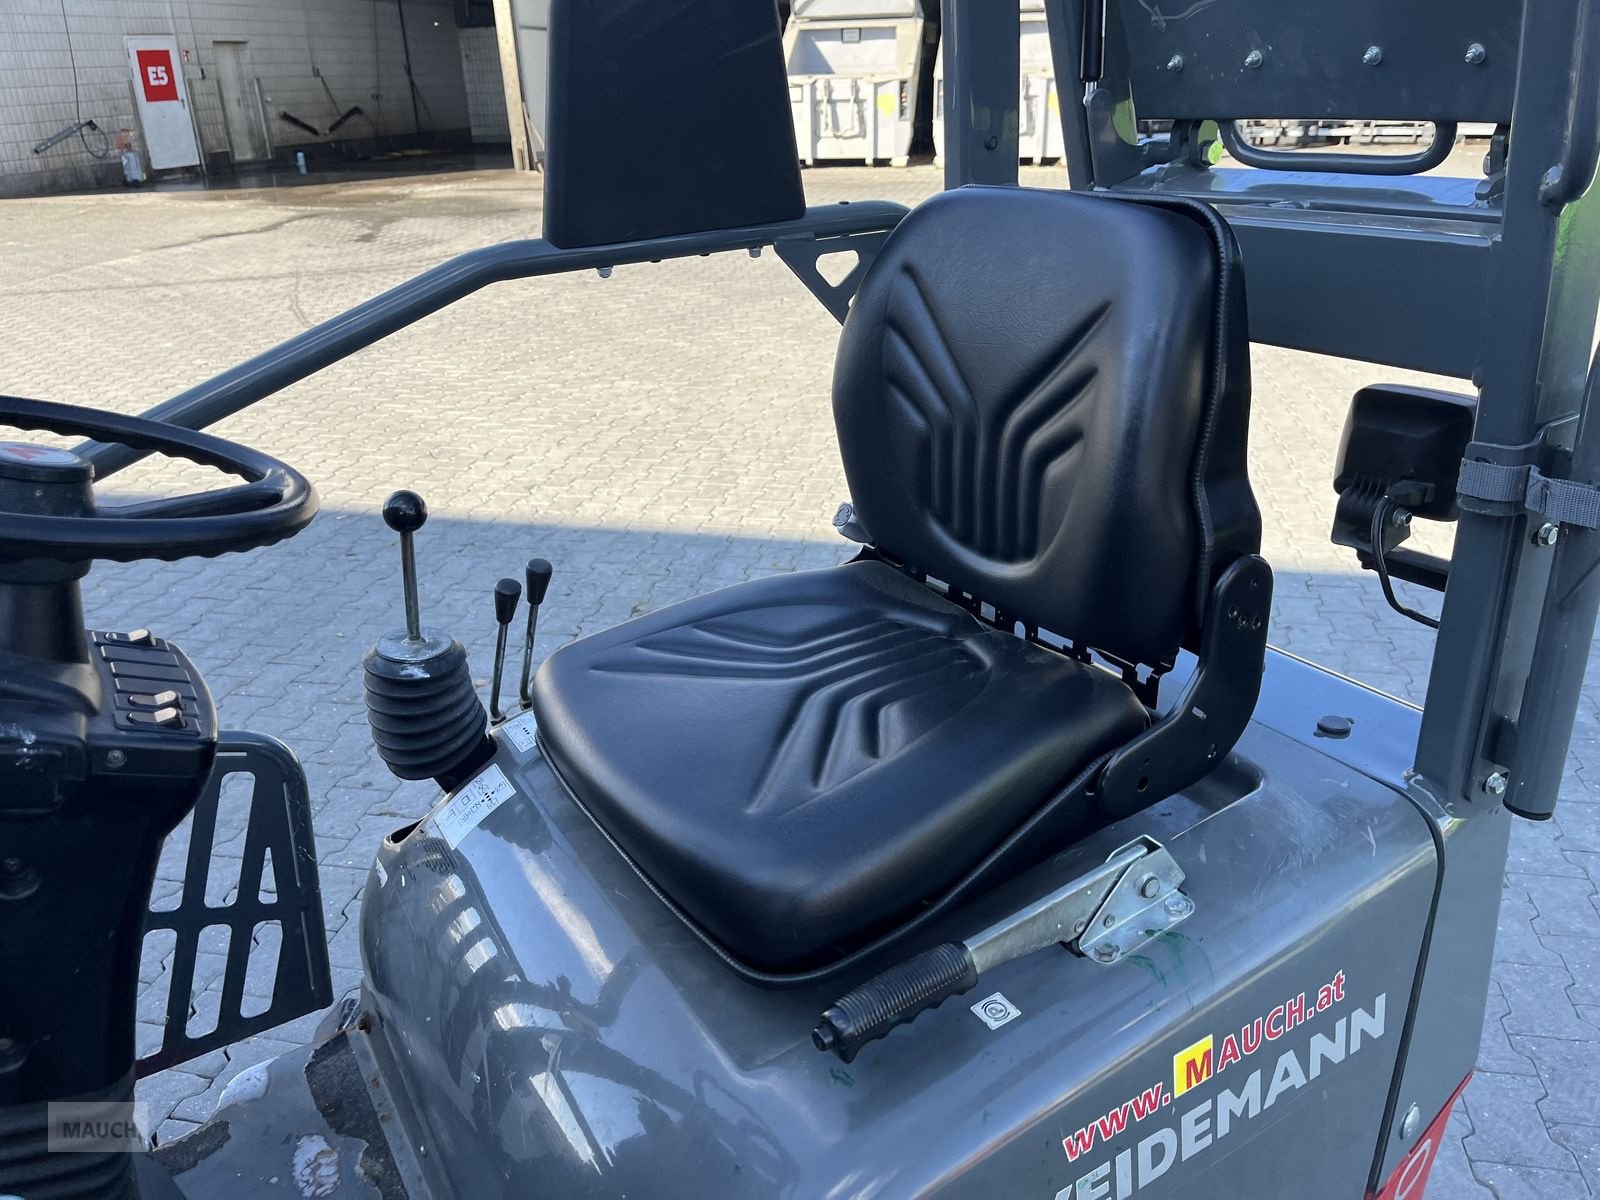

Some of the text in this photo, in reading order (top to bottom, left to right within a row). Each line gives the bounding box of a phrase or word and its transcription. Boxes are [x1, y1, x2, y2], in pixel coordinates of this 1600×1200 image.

[147, 66, 169, 86] E5
[1054, 992, 1386, 1200] EIDEMANN
[1062, 969, 1345, 1162] www.MAUCH.at
